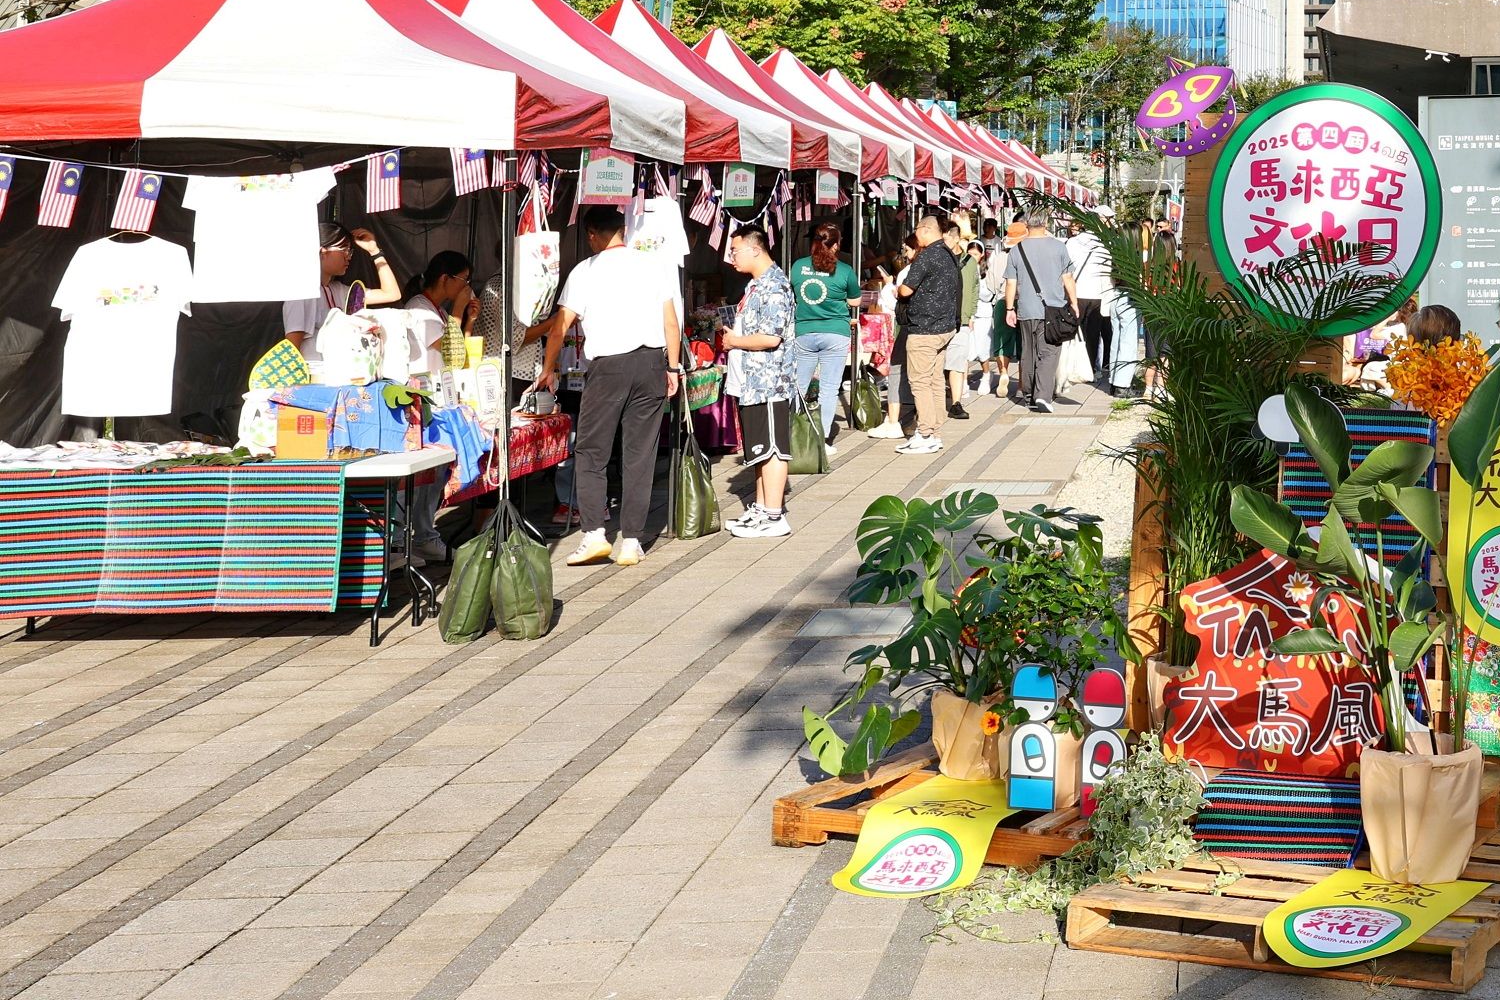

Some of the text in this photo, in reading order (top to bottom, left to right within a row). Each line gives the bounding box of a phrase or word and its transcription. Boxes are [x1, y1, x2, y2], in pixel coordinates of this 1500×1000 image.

[1248, 134, 1289, 155] 2025
[1295, 126, 1367, 151] 第四屆
[1244, 158, 1407, 212] 馬來西亞
[1244, 206, 1398, 266] 文化日
[1481, 545, 1499, 555] 2025
[1173, 671, 1386, 756] 大馬風
[876, 859, 949, 876] 馬來西亞
[867, 874, 938, 886] 文化日
[1333, 890, 1428, 908] 大馬風
[1302, 918, 1383, 938] 文化日
[1313, 934, 1338, 943] BUDAYA
